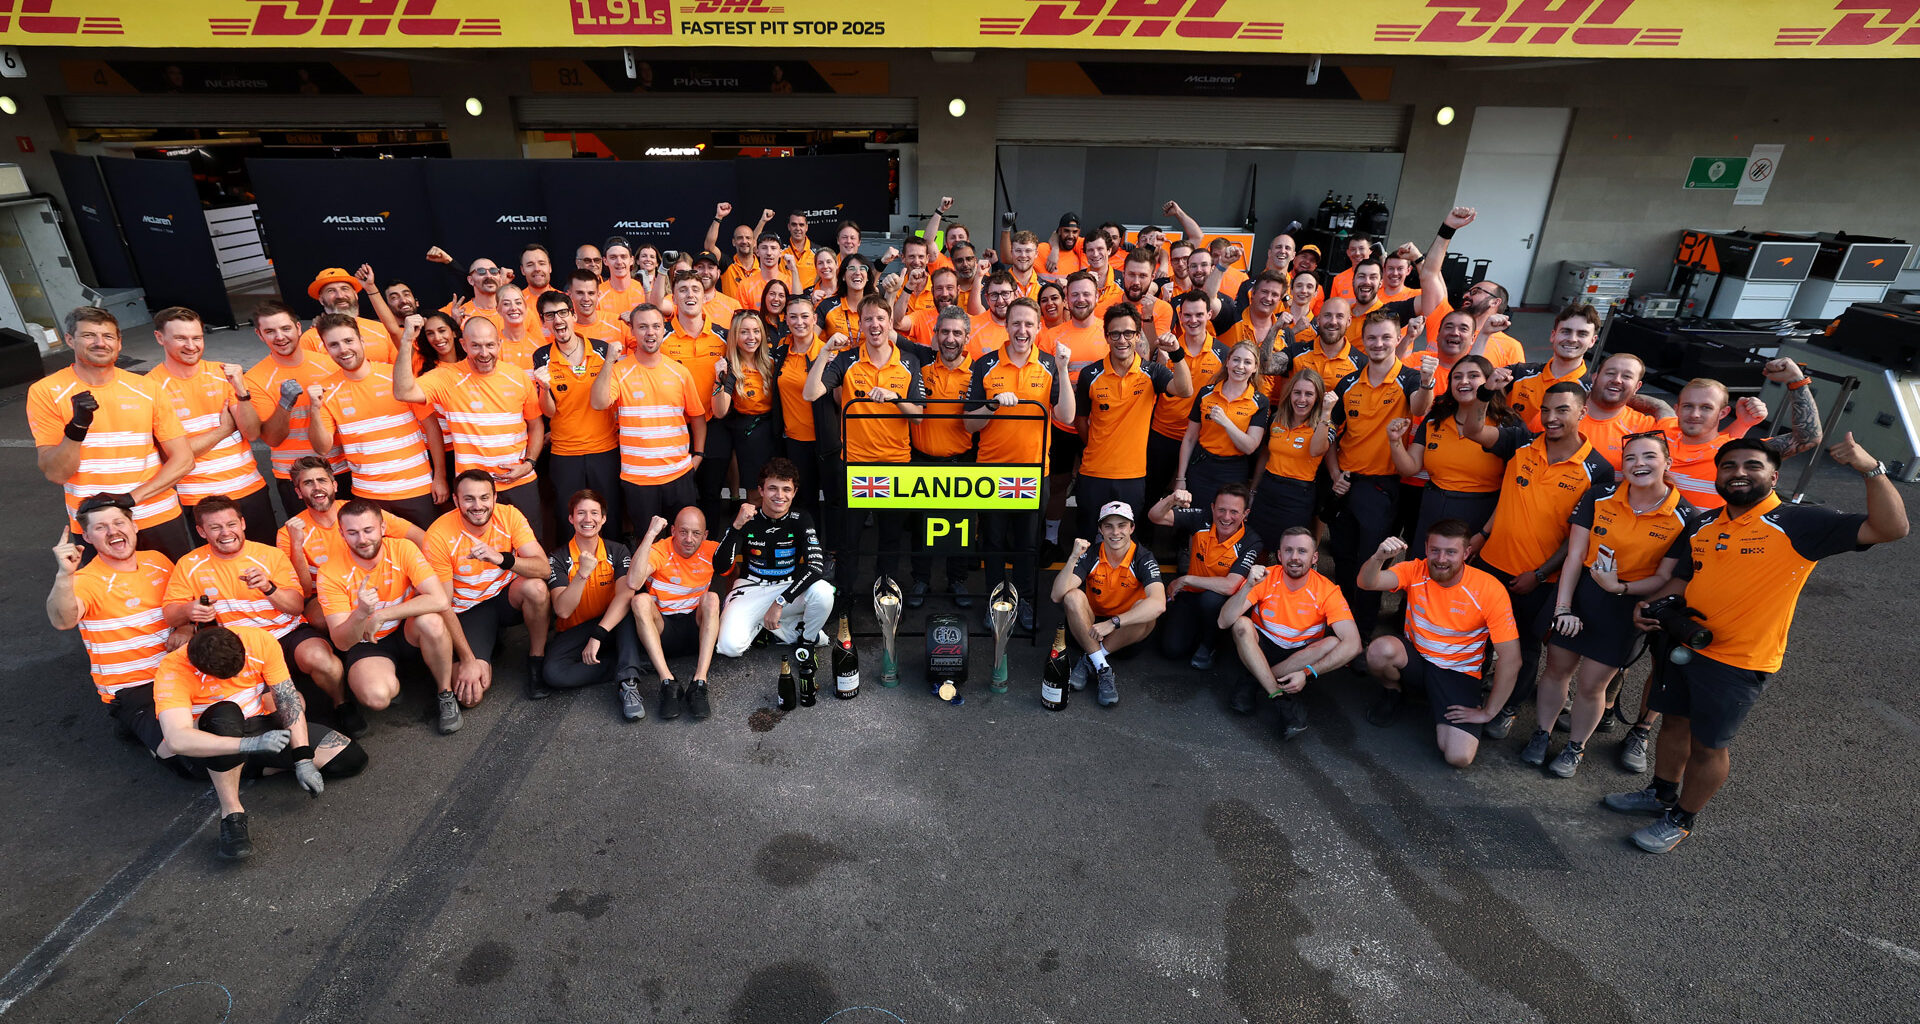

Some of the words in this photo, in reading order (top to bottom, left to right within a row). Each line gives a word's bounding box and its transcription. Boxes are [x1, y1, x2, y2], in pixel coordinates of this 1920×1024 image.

[251, 0, 460, 36] DHL
[577, 0, 667, 26] 1.91s
[1020, 0, 1244, 38] DHL
[1414, 0, 1643, 46] DHL
[681, 21, 757, 36] FASTEST
[760, 21, 789, 36] PIT
[793, 21, 838, 36] STOP
[842, 21, 885, 36] 2025
[5, 52, 17, 69] 6
[627, 52, 634, 70] 5
[204, 79, 268, 88] NORRIS
[673, 77, 739, 87] PIASTRI
[1184, 75, 1236, 84] McLaren
[645, 147, 700, 156] McLaren
[804, 208, 838, 217] cLaren
[322, 215, 384, 224] McLaren
[496, 215, 548, 223] McLare
[613, 220, 670, 229] McLaren
[1522, 464, 1534, 474] DELL
[893, 476, 996, 498] LANDO
[1558, 481, 1577, 492] OKX
[1598, 514, 1613, 524] DELL
[926, 517, 970, 547] P1
[1649, 531, 1668, 541] OKX
